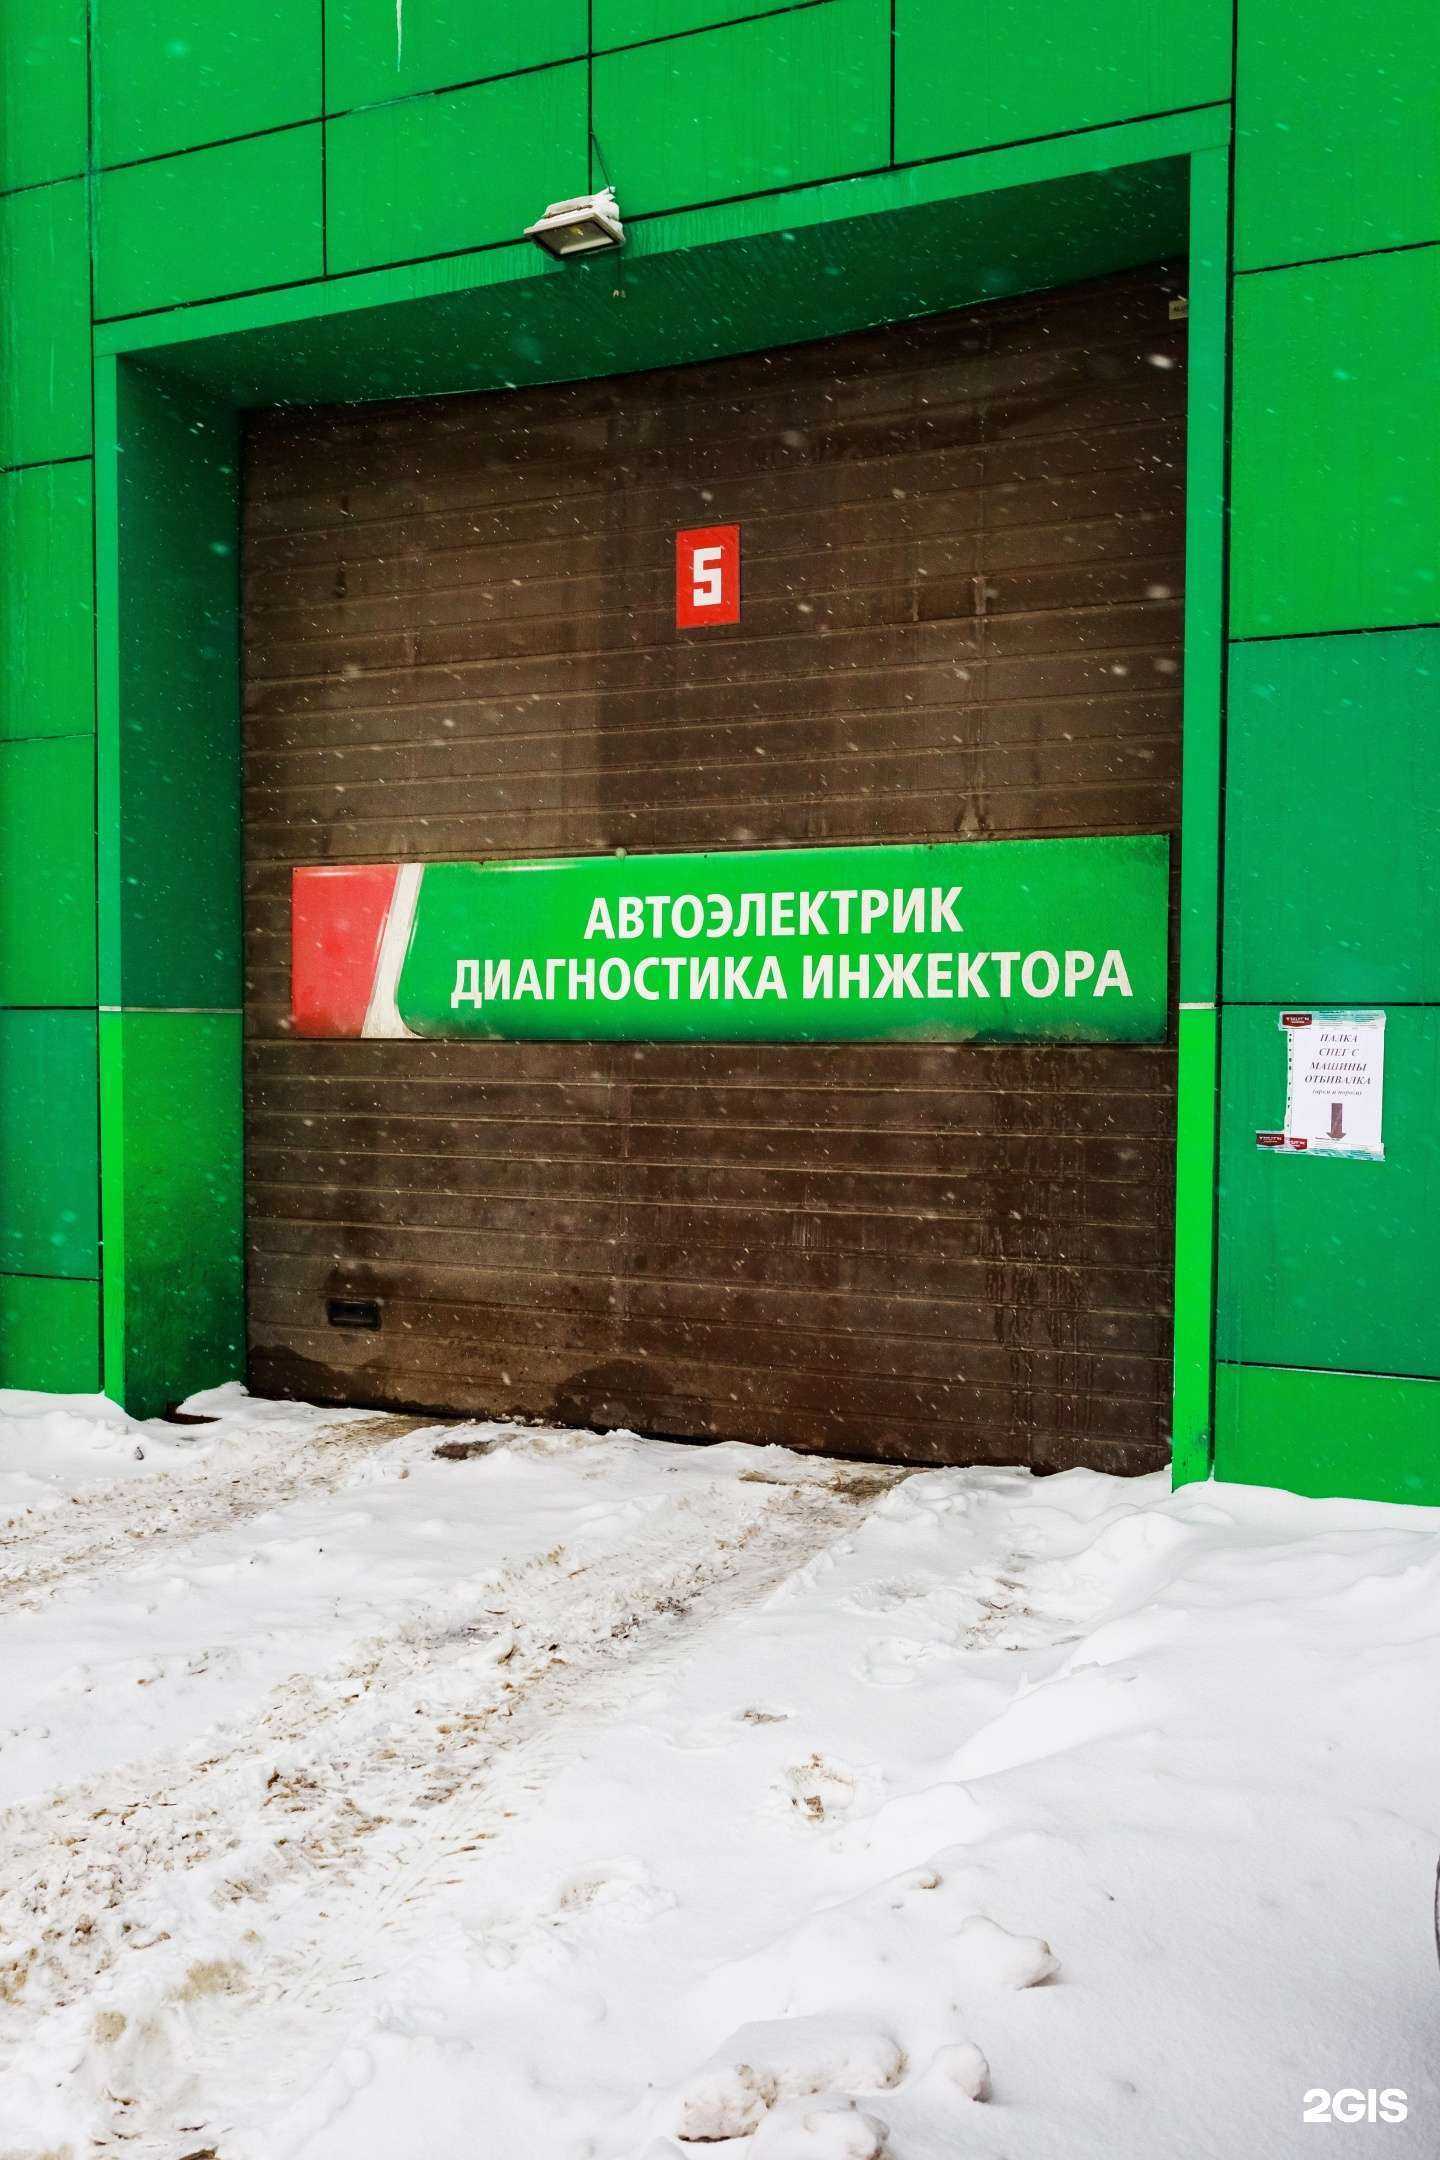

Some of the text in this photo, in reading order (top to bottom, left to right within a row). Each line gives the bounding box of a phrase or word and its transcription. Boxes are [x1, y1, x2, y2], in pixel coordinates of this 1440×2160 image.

[693, 546, 722, 607] 5
[583, 886, 964, 940] АВТОЭЛЕКТРИК
[450, 949, 1133, 1009] ДИАГНОСТИКА ИНЖЕКТОРА
[1320, 1033, 1358, 1043] ПАЛКА
[1304, 1075, 1371, 1085] ОТБИВАЛКА
[1310, 1061, 1367, 1071] МАШИНЫ
